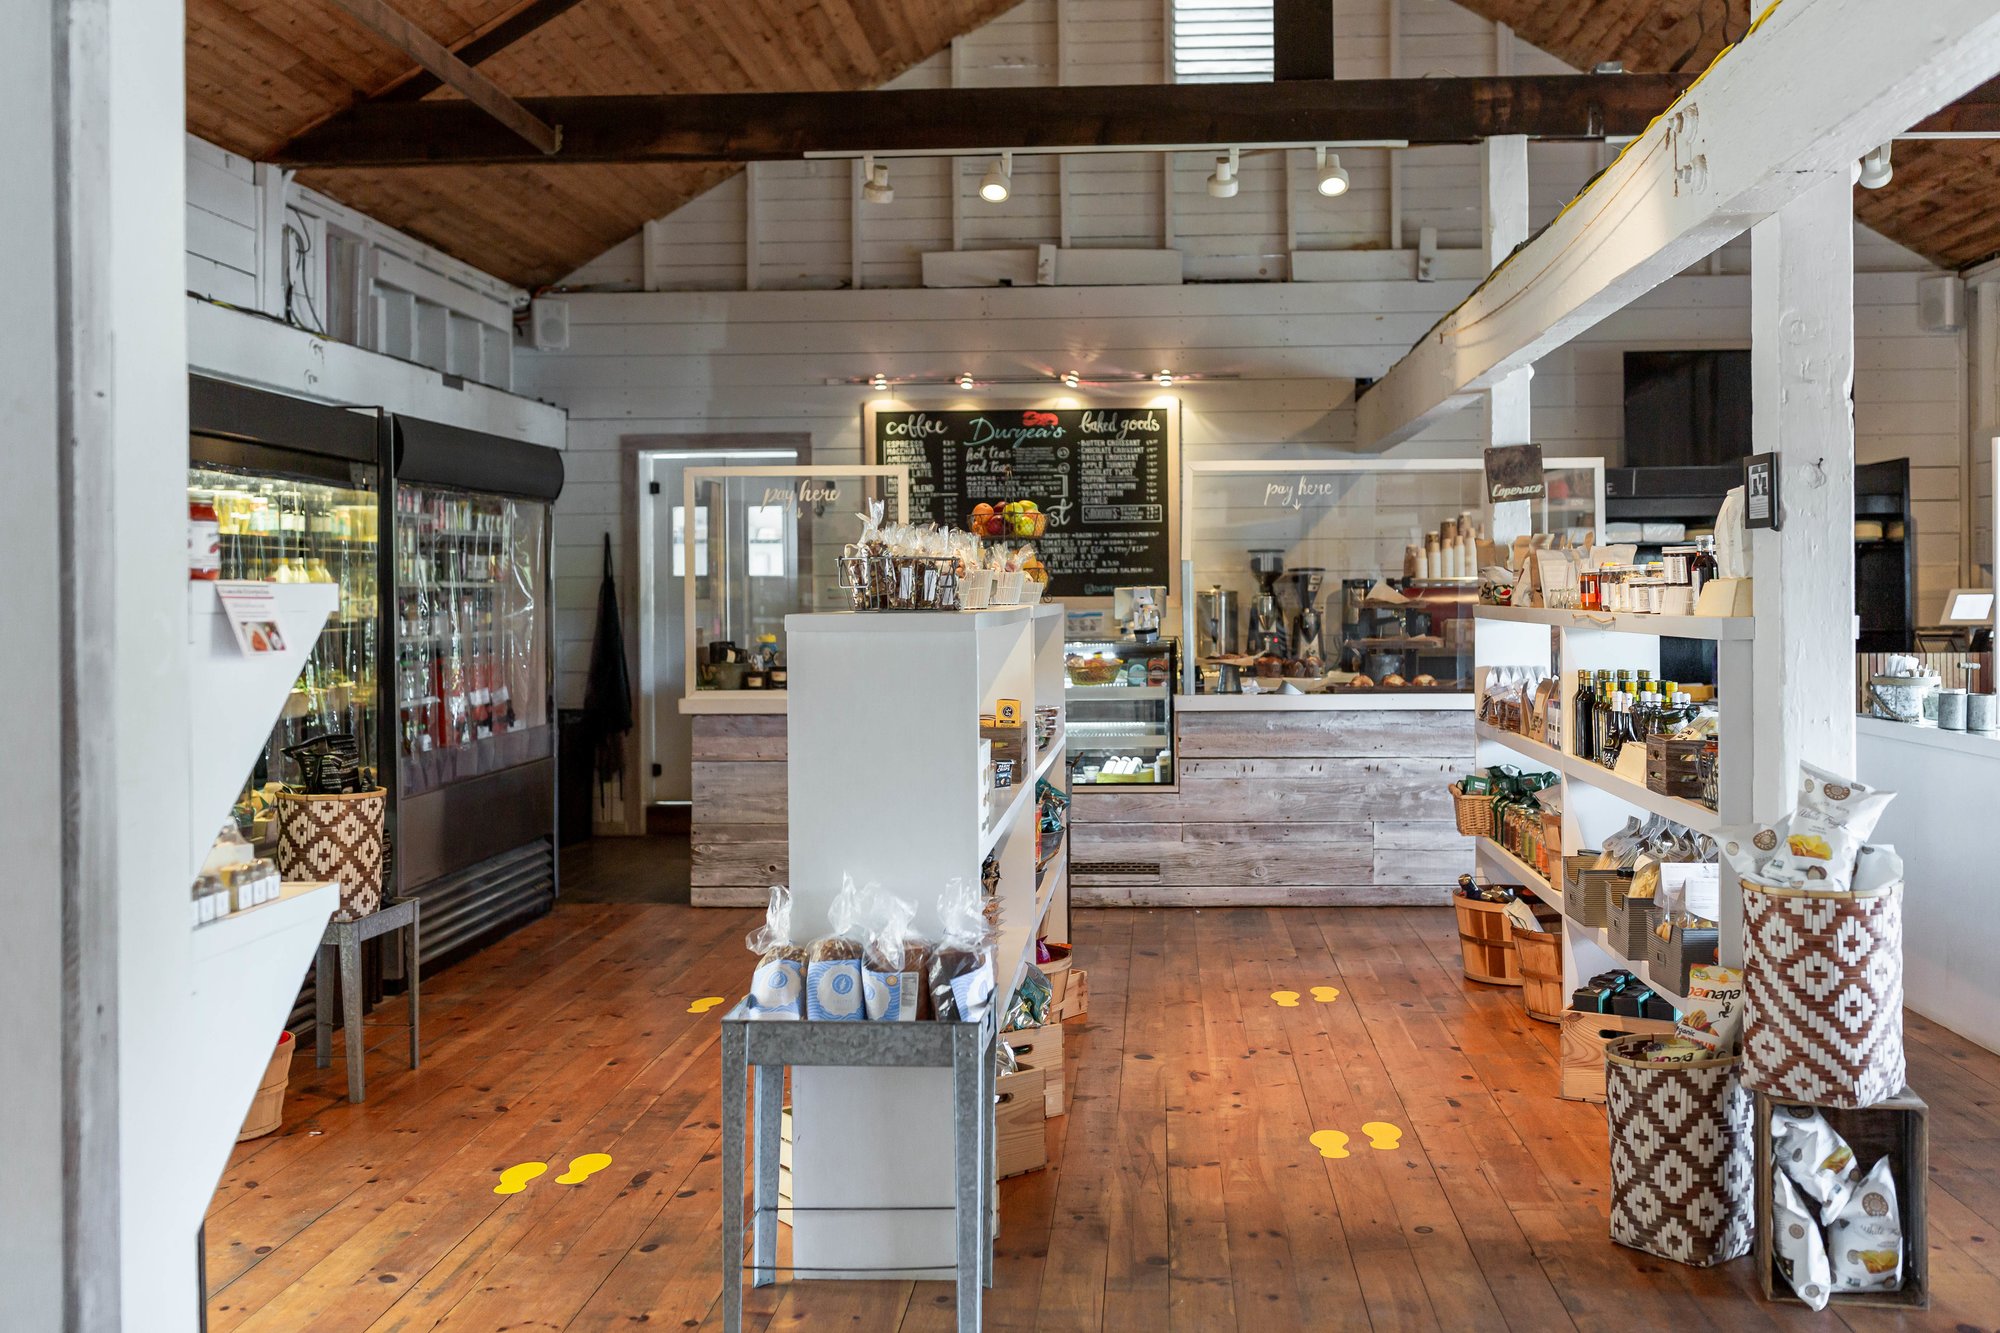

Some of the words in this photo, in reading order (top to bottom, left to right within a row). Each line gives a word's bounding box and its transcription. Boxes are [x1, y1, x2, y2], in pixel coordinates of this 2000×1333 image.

[885, 413, 948, 438] coffee
[963, 417, 1066, 449] Duryea's
[1079, 410, 1118, 433] baked
[1116, 410, 1160, 440] goods
[886, 440, 924, 448] ESPRESSO
[887, 455, 927, 463] AMERICANO
[966, 446, 986, 462] hot
[966, 459, 989, 473] iced
[760, 488, 795, 513] pay
[799, 480, 841, 502] here
[1264, 483, 1294, 506] pay
[1298, 475, 1335, 496] here
[1492, 483, 1545, 499] Coperaco
[1062, 560, 1096, 568] CHEESE
